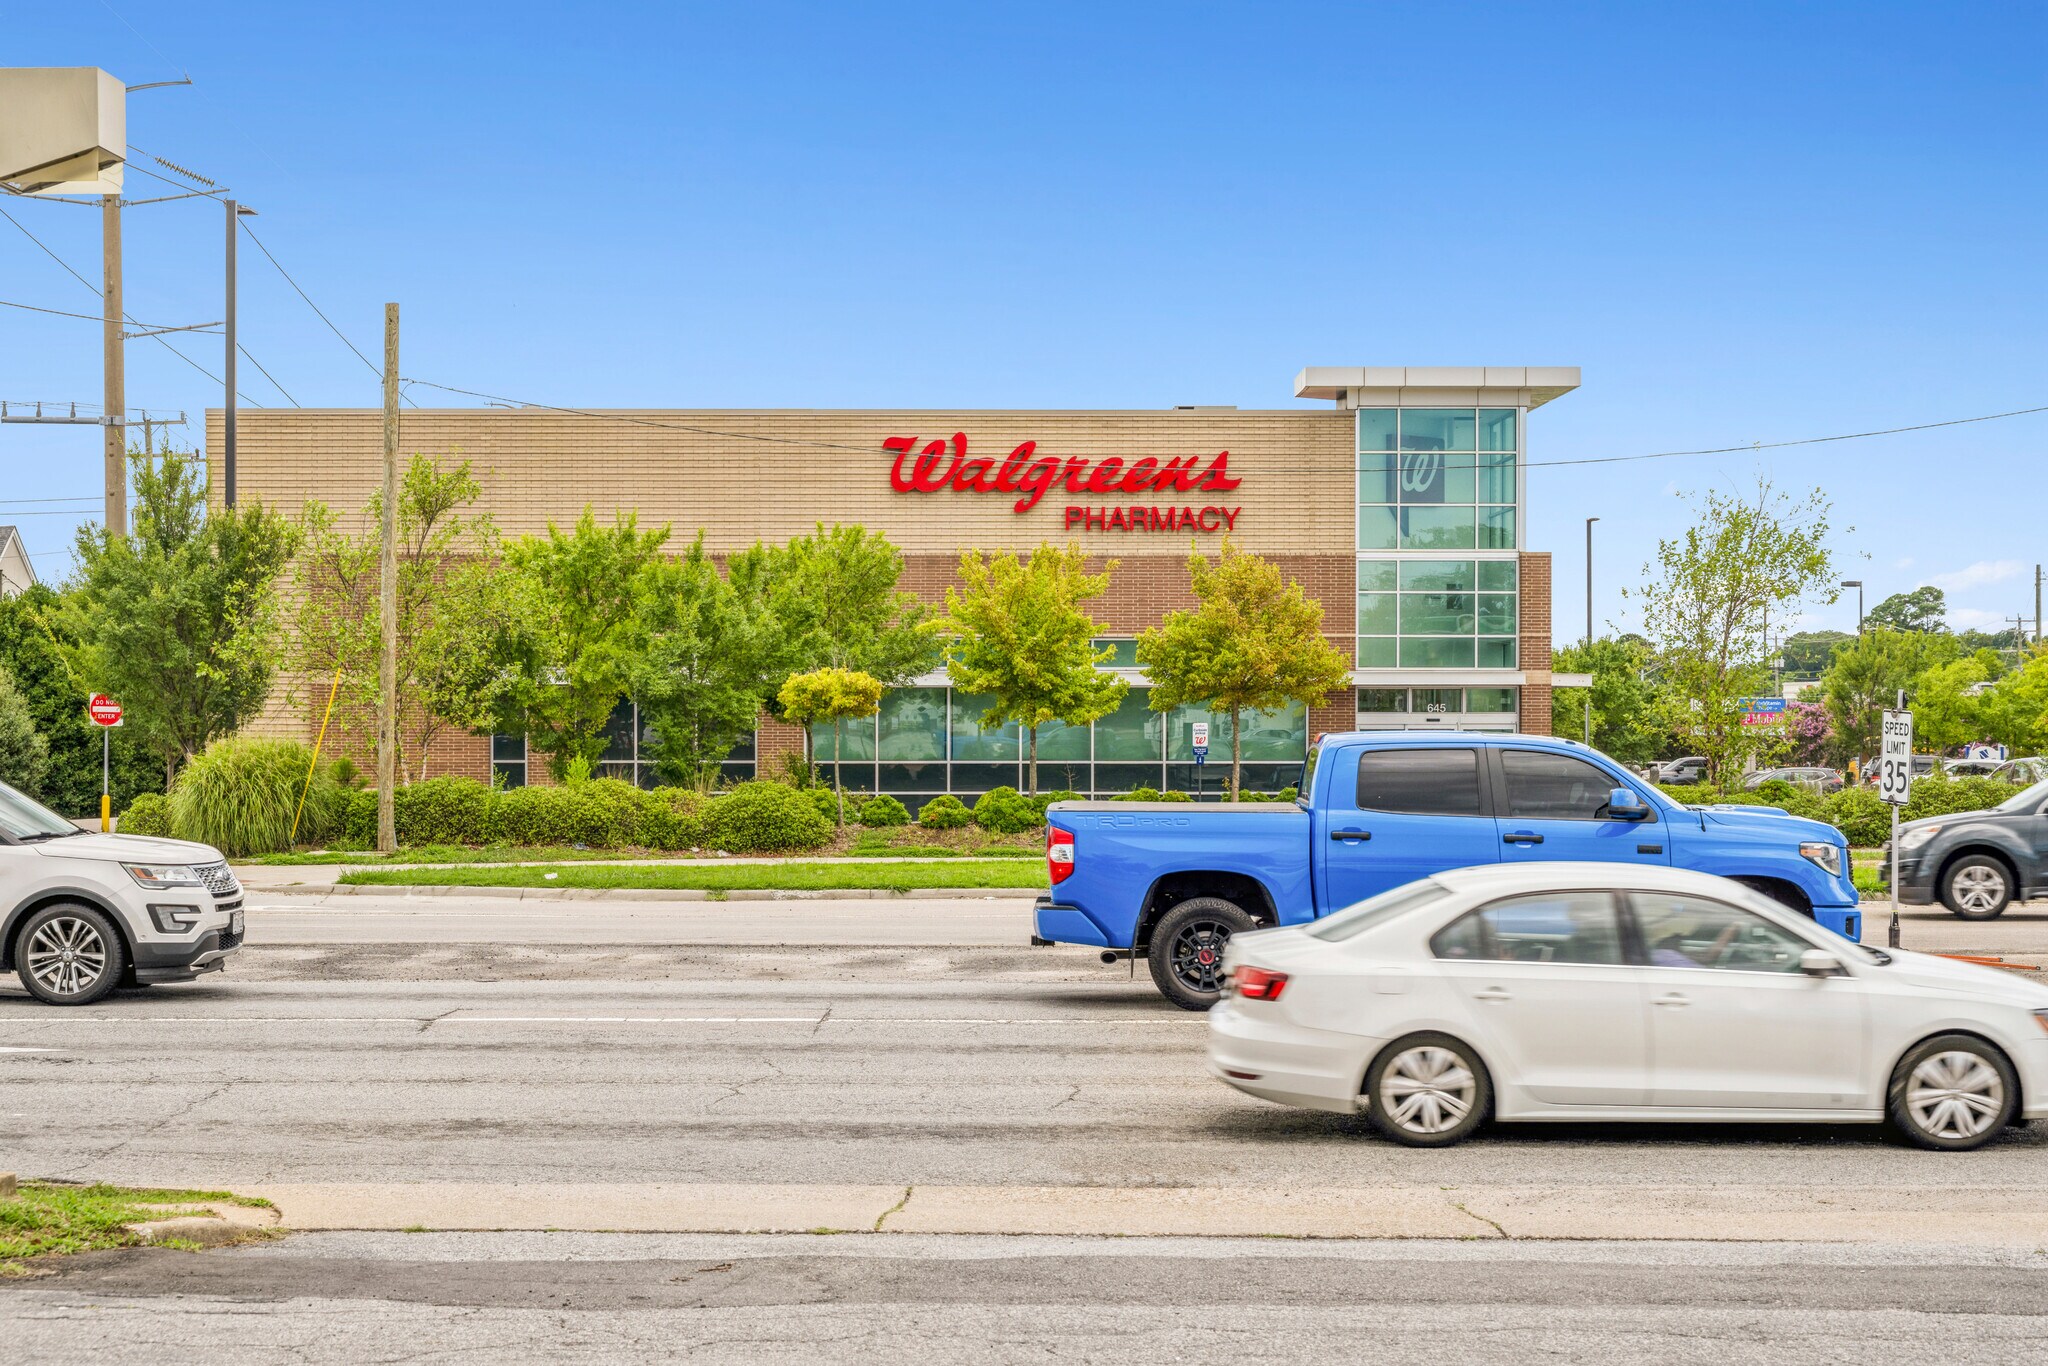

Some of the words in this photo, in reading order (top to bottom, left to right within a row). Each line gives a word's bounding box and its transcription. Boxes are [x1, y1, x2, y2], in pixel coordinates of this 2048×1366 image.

[882, 431, 1242, 513] Walgreens
[1064, 506, 1242, 532] PHARMACY
[1427, 703, 1446, 713] 645
[1884, 721, 1909, 736] SPEED
[1886, 740, 1906, 755] LIMIT
[1883, 760, 1907, 793] 35
[1076, 815, 1136, 829] TRD
[1138, 817, 1190, 827] PRO
